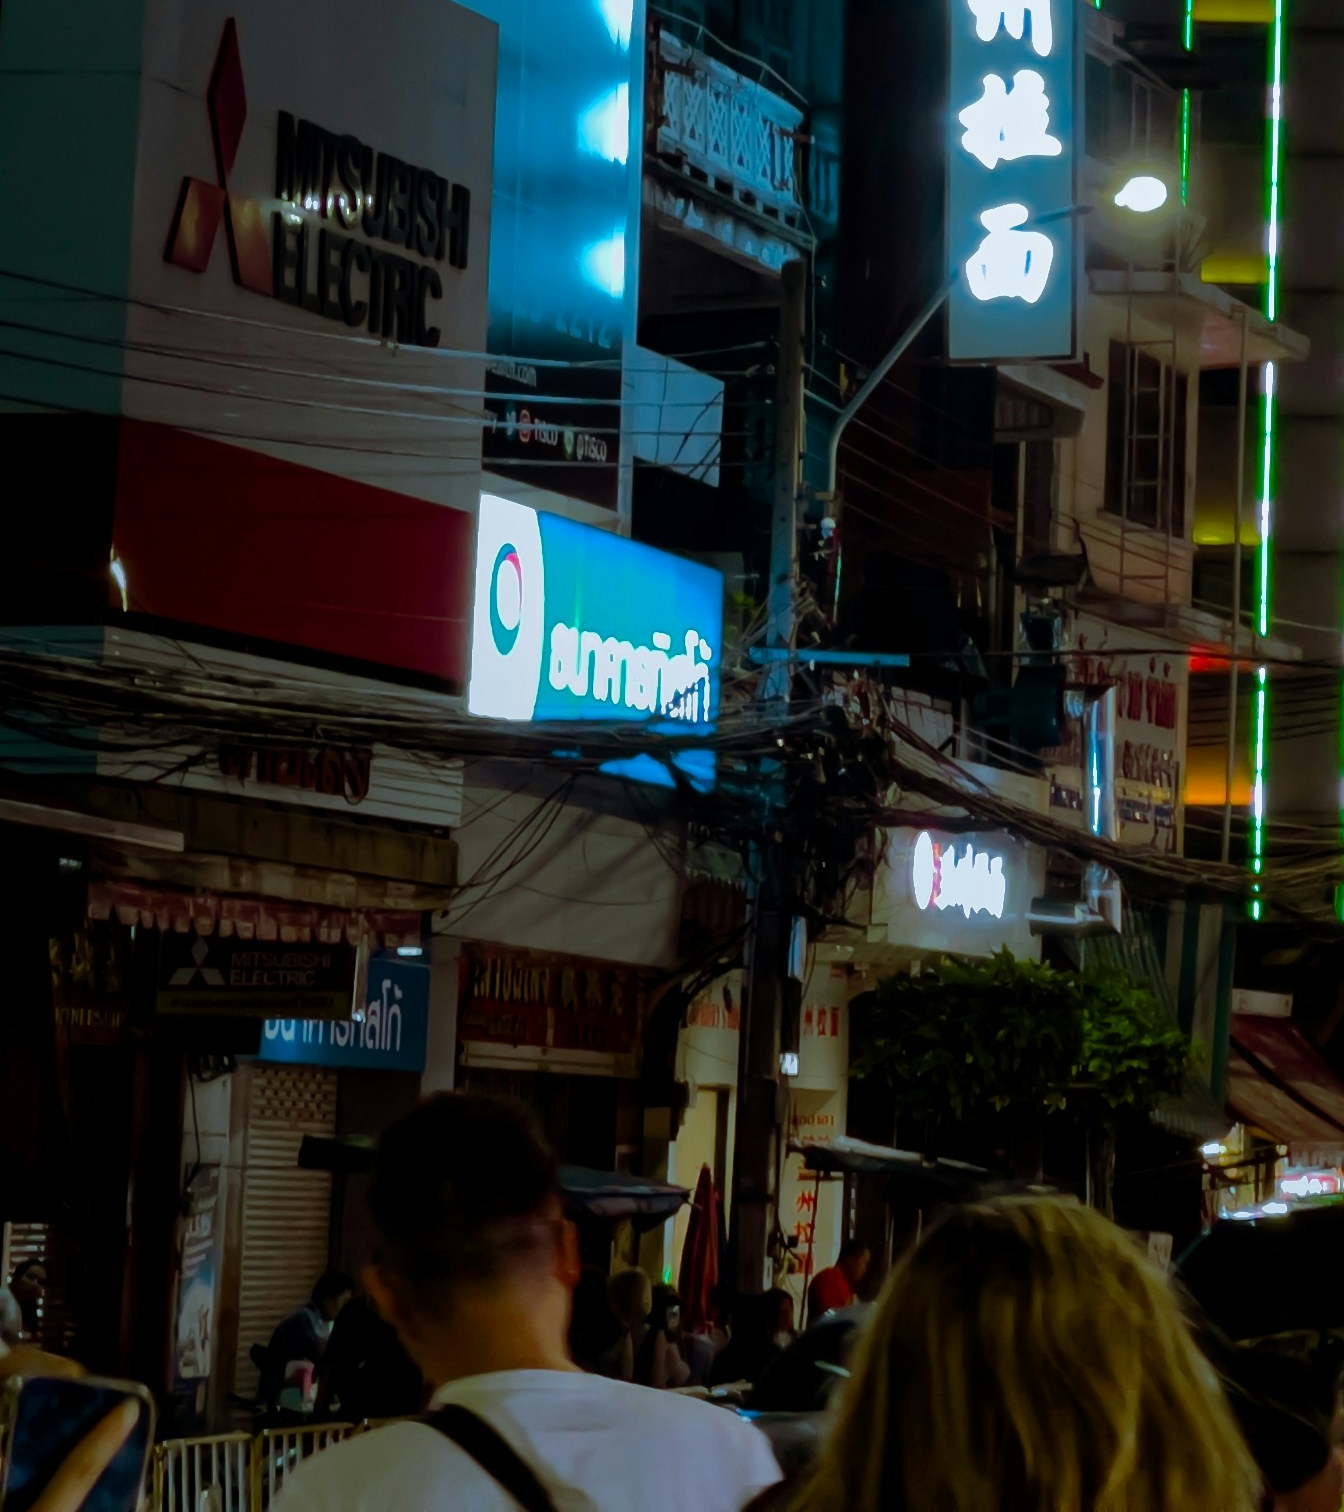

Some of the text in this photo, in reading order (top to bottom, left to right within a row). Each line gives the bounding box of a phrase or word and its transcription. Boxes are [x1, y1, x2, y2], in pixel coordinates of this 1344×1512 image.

[276, 110, 471, 270] MITSUBISHI
[273, 210, 442, 347] ELECTRIC
[229, 969, 315, 987] ELECTRIC
[230, 951, 333, 969] MITSUBISHI
